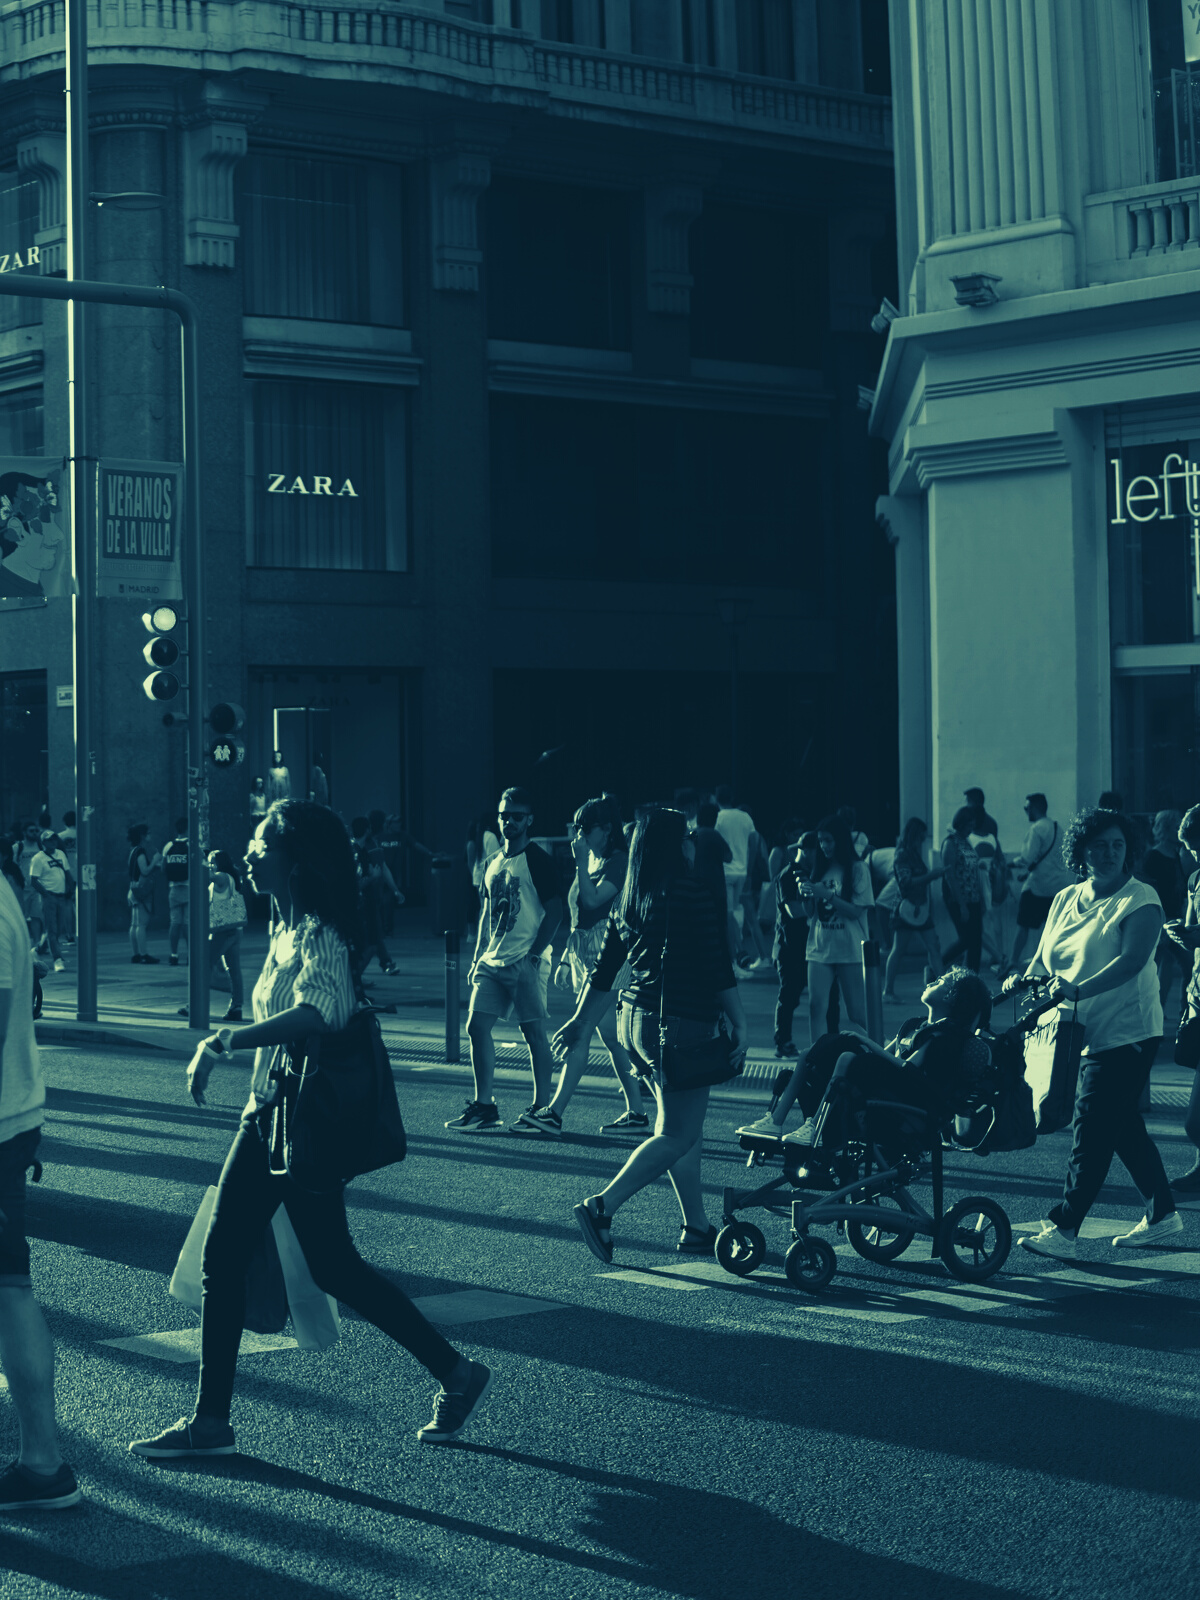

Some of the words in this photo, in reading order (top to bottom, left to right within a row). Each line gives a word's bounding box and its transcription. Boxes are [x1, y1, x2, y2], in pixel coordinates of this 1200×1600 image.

[107, 474, 172, 520] VERANOS
[267, 473, 360, 498] ZARA
[106, 519, 121, 553] DE
[124, 520, 137, 554] LA
[140, 521, 171, 557] VILLA
[128, 585, 160, 595] MADRID
